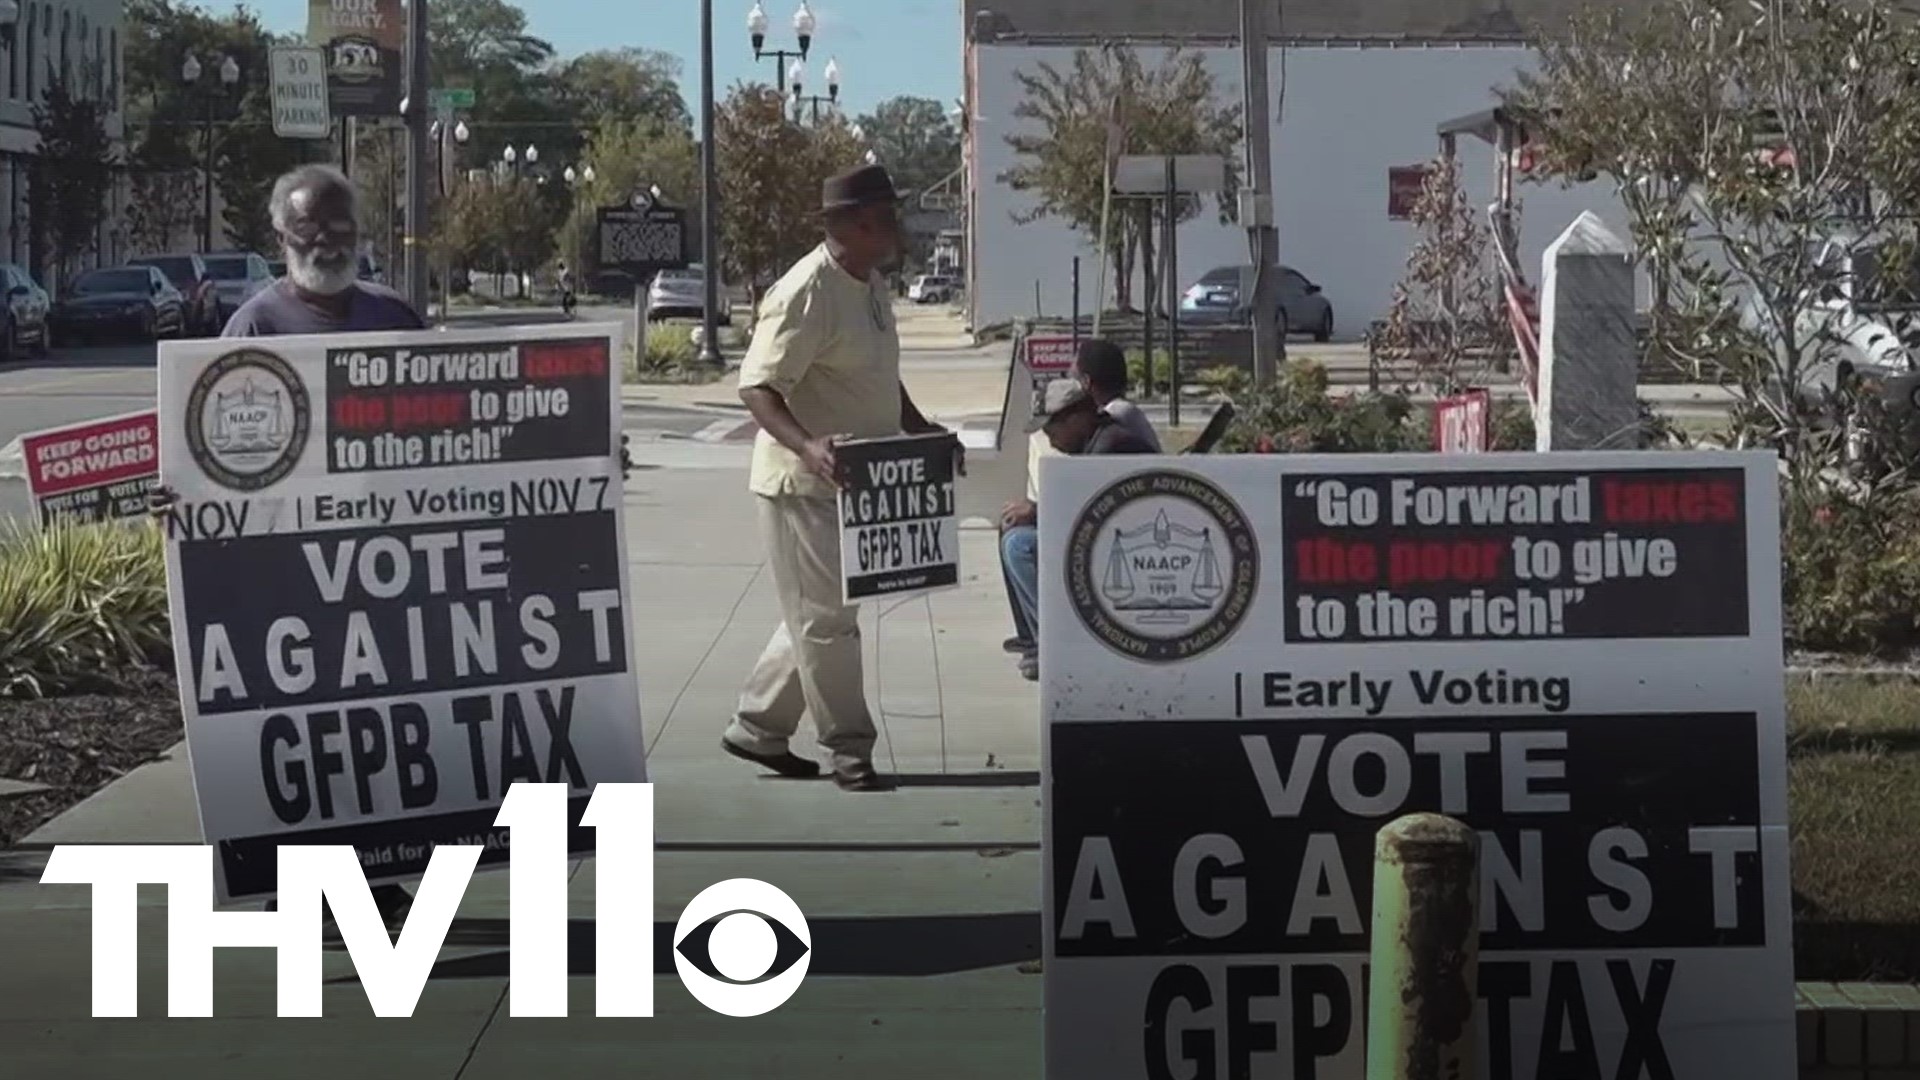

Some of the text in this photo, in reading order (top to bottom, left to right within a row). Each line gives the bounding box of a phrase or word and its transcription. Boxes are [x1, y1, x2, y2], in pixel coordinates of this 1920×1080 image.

[287, 58, 308, 74] 30
[277, 83, 321, 99] MINUTE
[279, 108, 323, 125] PARKING
[395, 346, 519, 384] Forward
[230, 411, 268, 424] NAACP
[470, 389, 500, 421] to
[506, 385, 570, 423] give
[36, 426, 151, 462] KEEP GOING
[41, 444, 155, 482] FORWARD
[334, 436, 367, 469] to
[373, 432, 424, 468] the
[868, 458, 925, 487] VOTE
[167, 500, 249, 540] NOV
[315, 491, 396, 524] Early
[406, 484, 505, 516] Voting
[510, 477, 581, 516] NOV
[589, 476, 610, 513] 7
[844, 482, 953, 524] AGAINST
[1120, 478, 1146, 497] THE
[1152, 477, 1241, 528] ADVANCEMENT
[1391, 476, 1591, 526] Forward
[1605, 480, 1738, 524] taxes
[302, 528, 508, 602] VOTE
[858, 521, 943, 572] GFPB TAX
[1133, 555, 1192, 570] NAACP
[1296, 531, 1678, 585] the poor to give
[1149, 583, 1177, 595] 1909
[1296, 593, 1346, 638] to
[1356, 590, 1438, 637] the
[199, 589, 619, 701] AGAINST
[1264, 669, 1571, 715] Early Voting
[260, 686, 588, 826] GFPB TAX
[1240, 730, 1570, 818] VOTE
[397, 843, 424, 861] for
[457, 831, 510, 850] NAAC
[1059, 825, 1757, 939] AGANST
[1144, 959, 1675, 1080] GFP TAX
